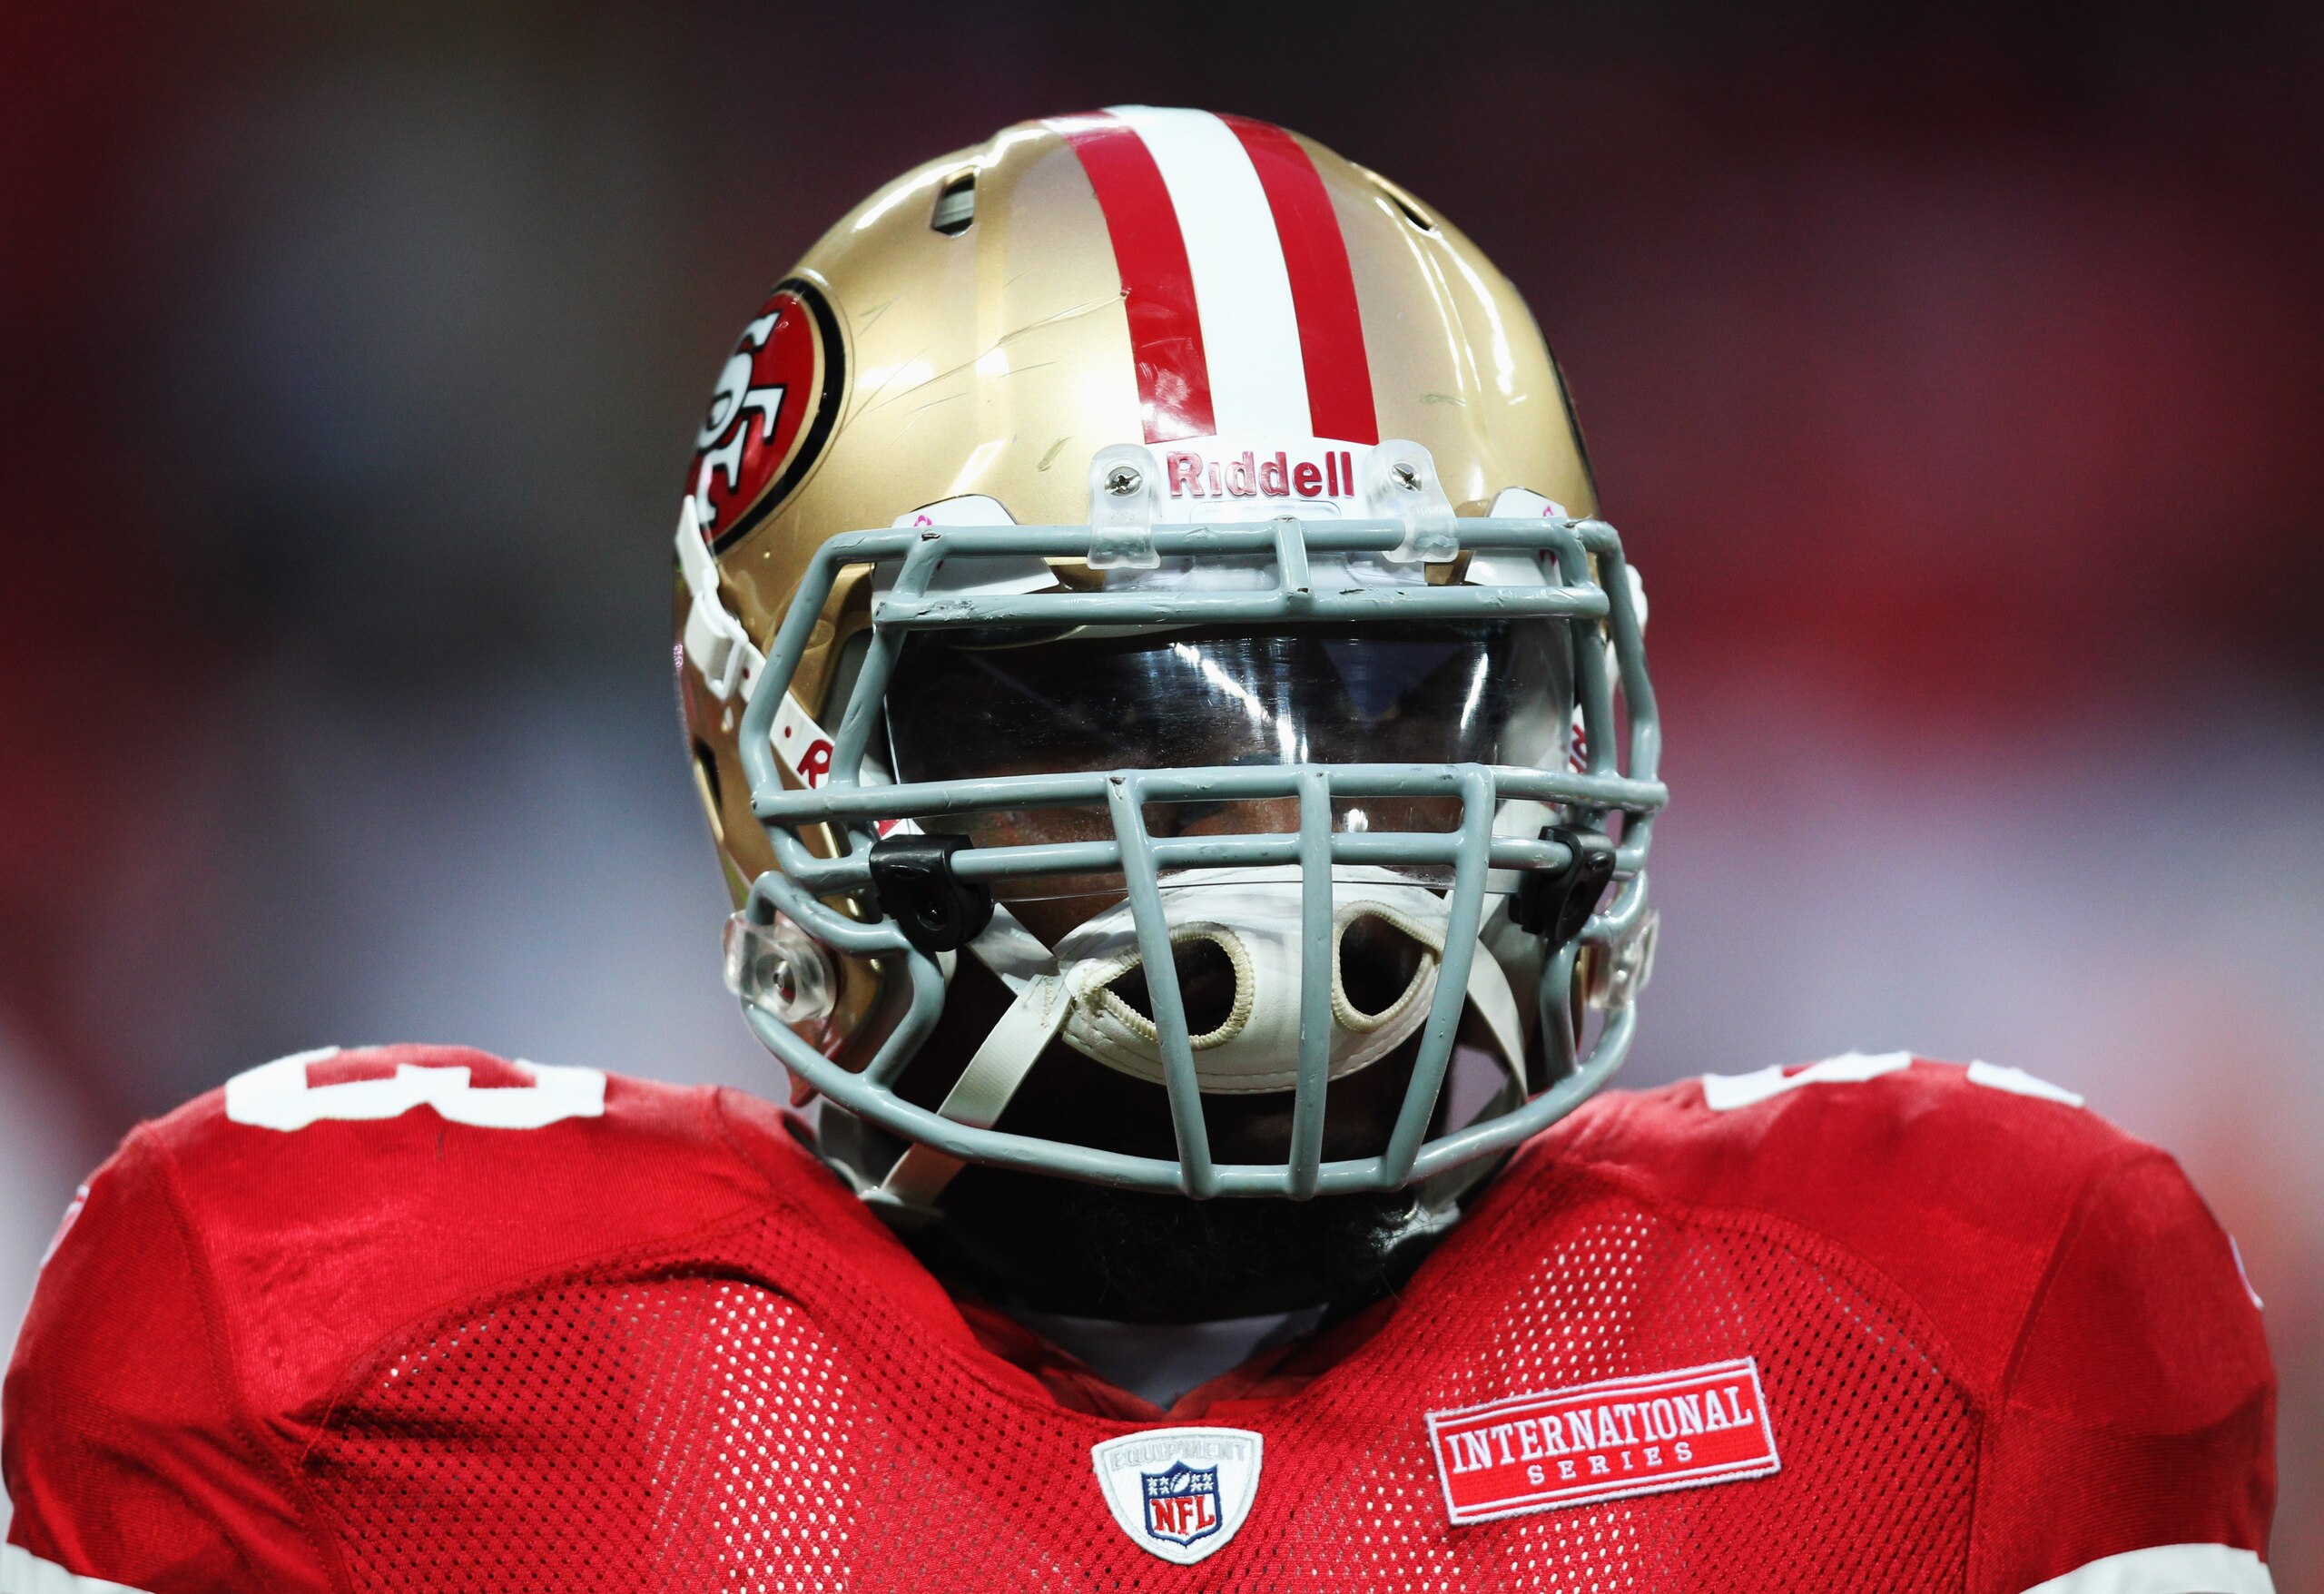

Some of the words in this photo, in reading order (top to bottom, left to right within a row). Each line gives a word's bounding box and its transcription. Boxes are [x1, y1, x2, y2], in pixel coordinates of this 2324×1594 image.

[1167, 450, 1355, 498] Riddell
[1444, 1385, 1755, 1475] INTERNATIONAL
[1110, 1437, 1247, 1472] EQUIPMENT
[1527, 1441, 1694, 1486] SERIES
[1150, 1494, 1216, 1536] NFL
